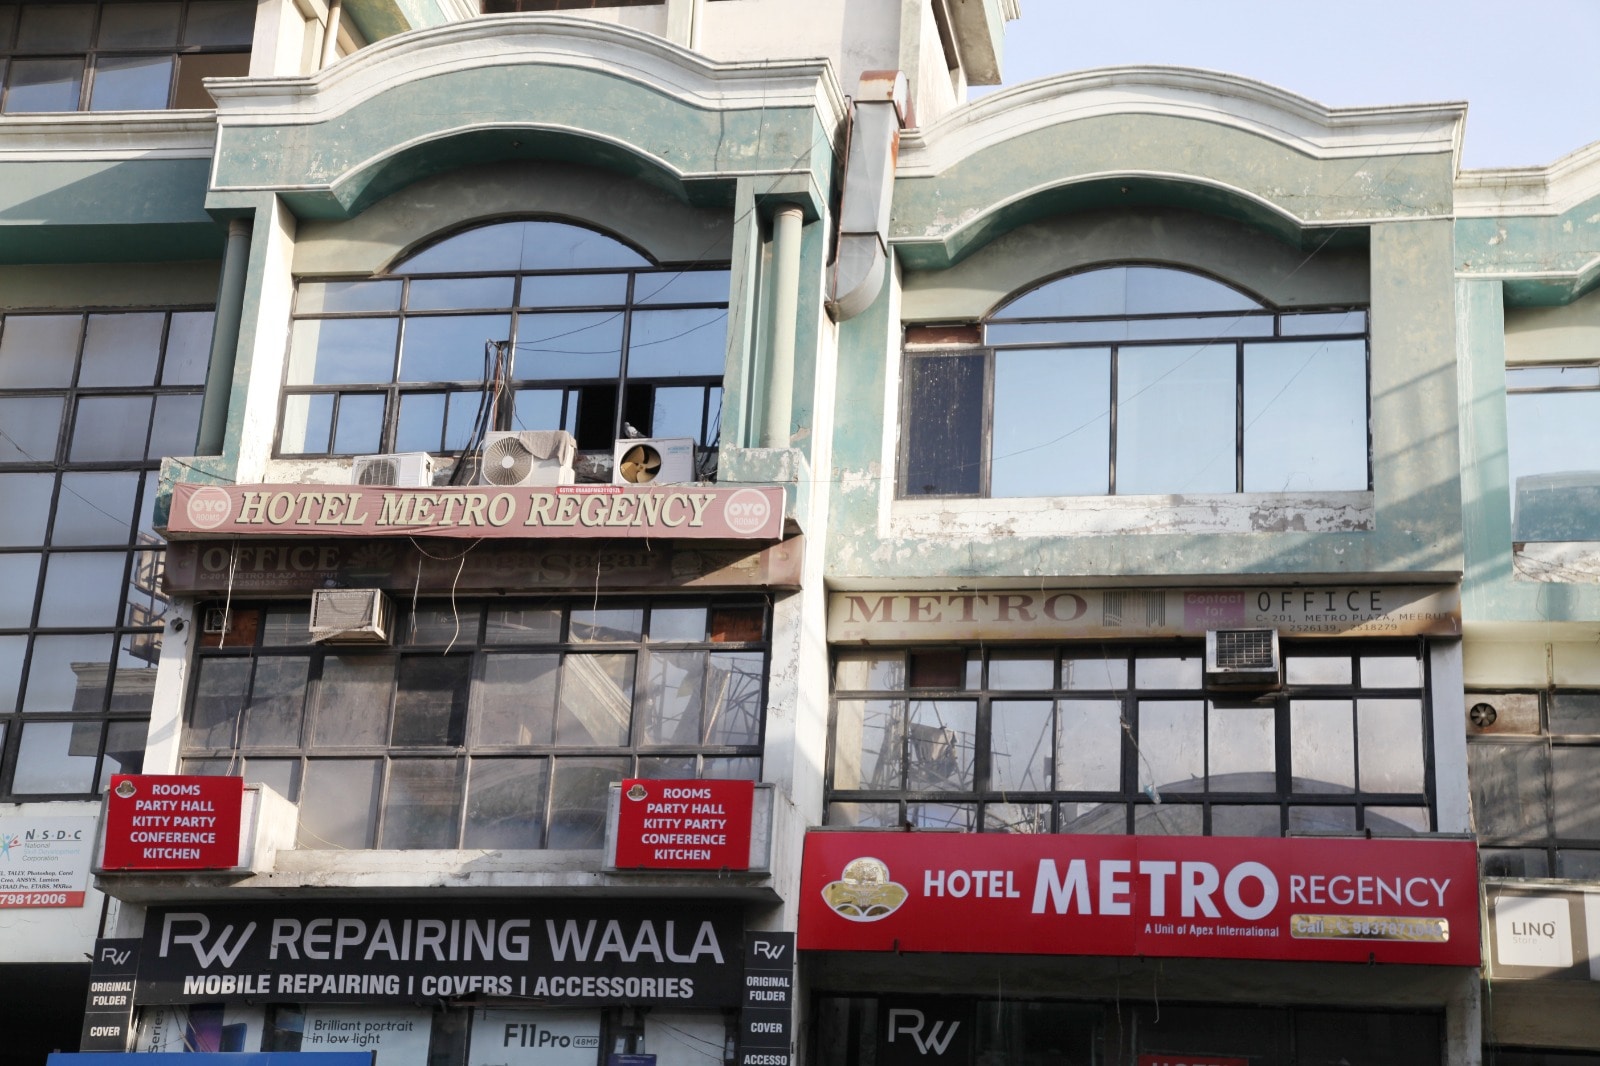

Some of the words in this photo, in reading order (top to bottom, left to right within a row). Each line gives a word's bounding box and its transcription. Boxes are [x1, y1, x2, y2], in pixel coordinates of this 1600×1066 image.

[191, 500, 226, 512] OYO
[234, 491, 369, 525] HOTEL
[376, 493, 516, 527] METRO
[523, 492, 716, 527] REGENCY
[728, 503, 765, 516] OYO
[202, 546, 341, 572] OFFICE
[1187, 594, 1242, 604] Contact
[1257, 590, 1383, 612] OFFICE
[843, 594, 1088, 623] METRO
[1206, 606, 1224, 617] for
[1305, 614, 1347, 622] METRO
[1352, 613, 1395, 622] PLAZA,
[1400, 613, 1449, 621] MEERUT
[1350, 623, 1398, 631] 2518279
[152, 784, 201, 797] ROOMS
[663, 788, 711, 799] ROOMS
[135, 800, 178, 812] PARTY
[181, 800, 215, 812] HALL
[646, 803, 689, 815] PARTY
[691, 803, 726, 815] HALL
[132, 816, 171, 828] KITTY
[174, 816, 216, 828] PARTY
[643, 818, 682, 830] KITTY
[684, 818, 727, 830] PARTY
[130, 831, 216, 844] CONFERENCE
[641, 833, 727, 846] CONFERENCE
[143, 847, 201, 860] KITCHEN
[654, 849, 711, 861] KITCHEN
[923, 869, 1020, 899] HOTEL
[1031, 859, 1279, 921] METRO
[1290, 875, 1451, 907] REGENCY
[1144, 924, 1152, 934] A
[1154, 923, 1174, 934] Unit
[1177, 925, 1187, 934] of
[1189, 924, 1214, 937] Apex
[1216, 925, 1279, 937] International
[1296, 920, 1324, 933] Call
[159, 912, 257, 969] RW
[269, 919, 530, 963] REPAIRING
[545, 920, 725, 965] WAALA
[101, 947, 131, 965] RW
[753, 940, 785, 960] RW
[91, 981, 132, 992] ORIGINAL
[183, 975, 271, 995] MOBILE
[277, 975, 400, 995] REPAIRING
[421, 976, 512, 997] COVERS
[533, 977, 694, 999] ACCESSORIES
[746, 976, 790, 988] ORIGINAL
[92, 995, 127, 1006] FOLDER
[749, 990, 786, 1002] FOLDER
[90, 1026, 120, 1037] COVER
[314, 1020, 362, 1032] Brilliant
[364, 1020, 413, 1034] portrait
[750, 1022, 783, 1033] COVER
[888, 1008, 960, 1055] RW
[311, 1032, 325, 1044] in
[326, 1033, 351, 1045] low
[353, 1032, 380, 1048] light
[539, 1030, 571, 1048] Pro
[575, 1038, 598, 1046] 48MP
